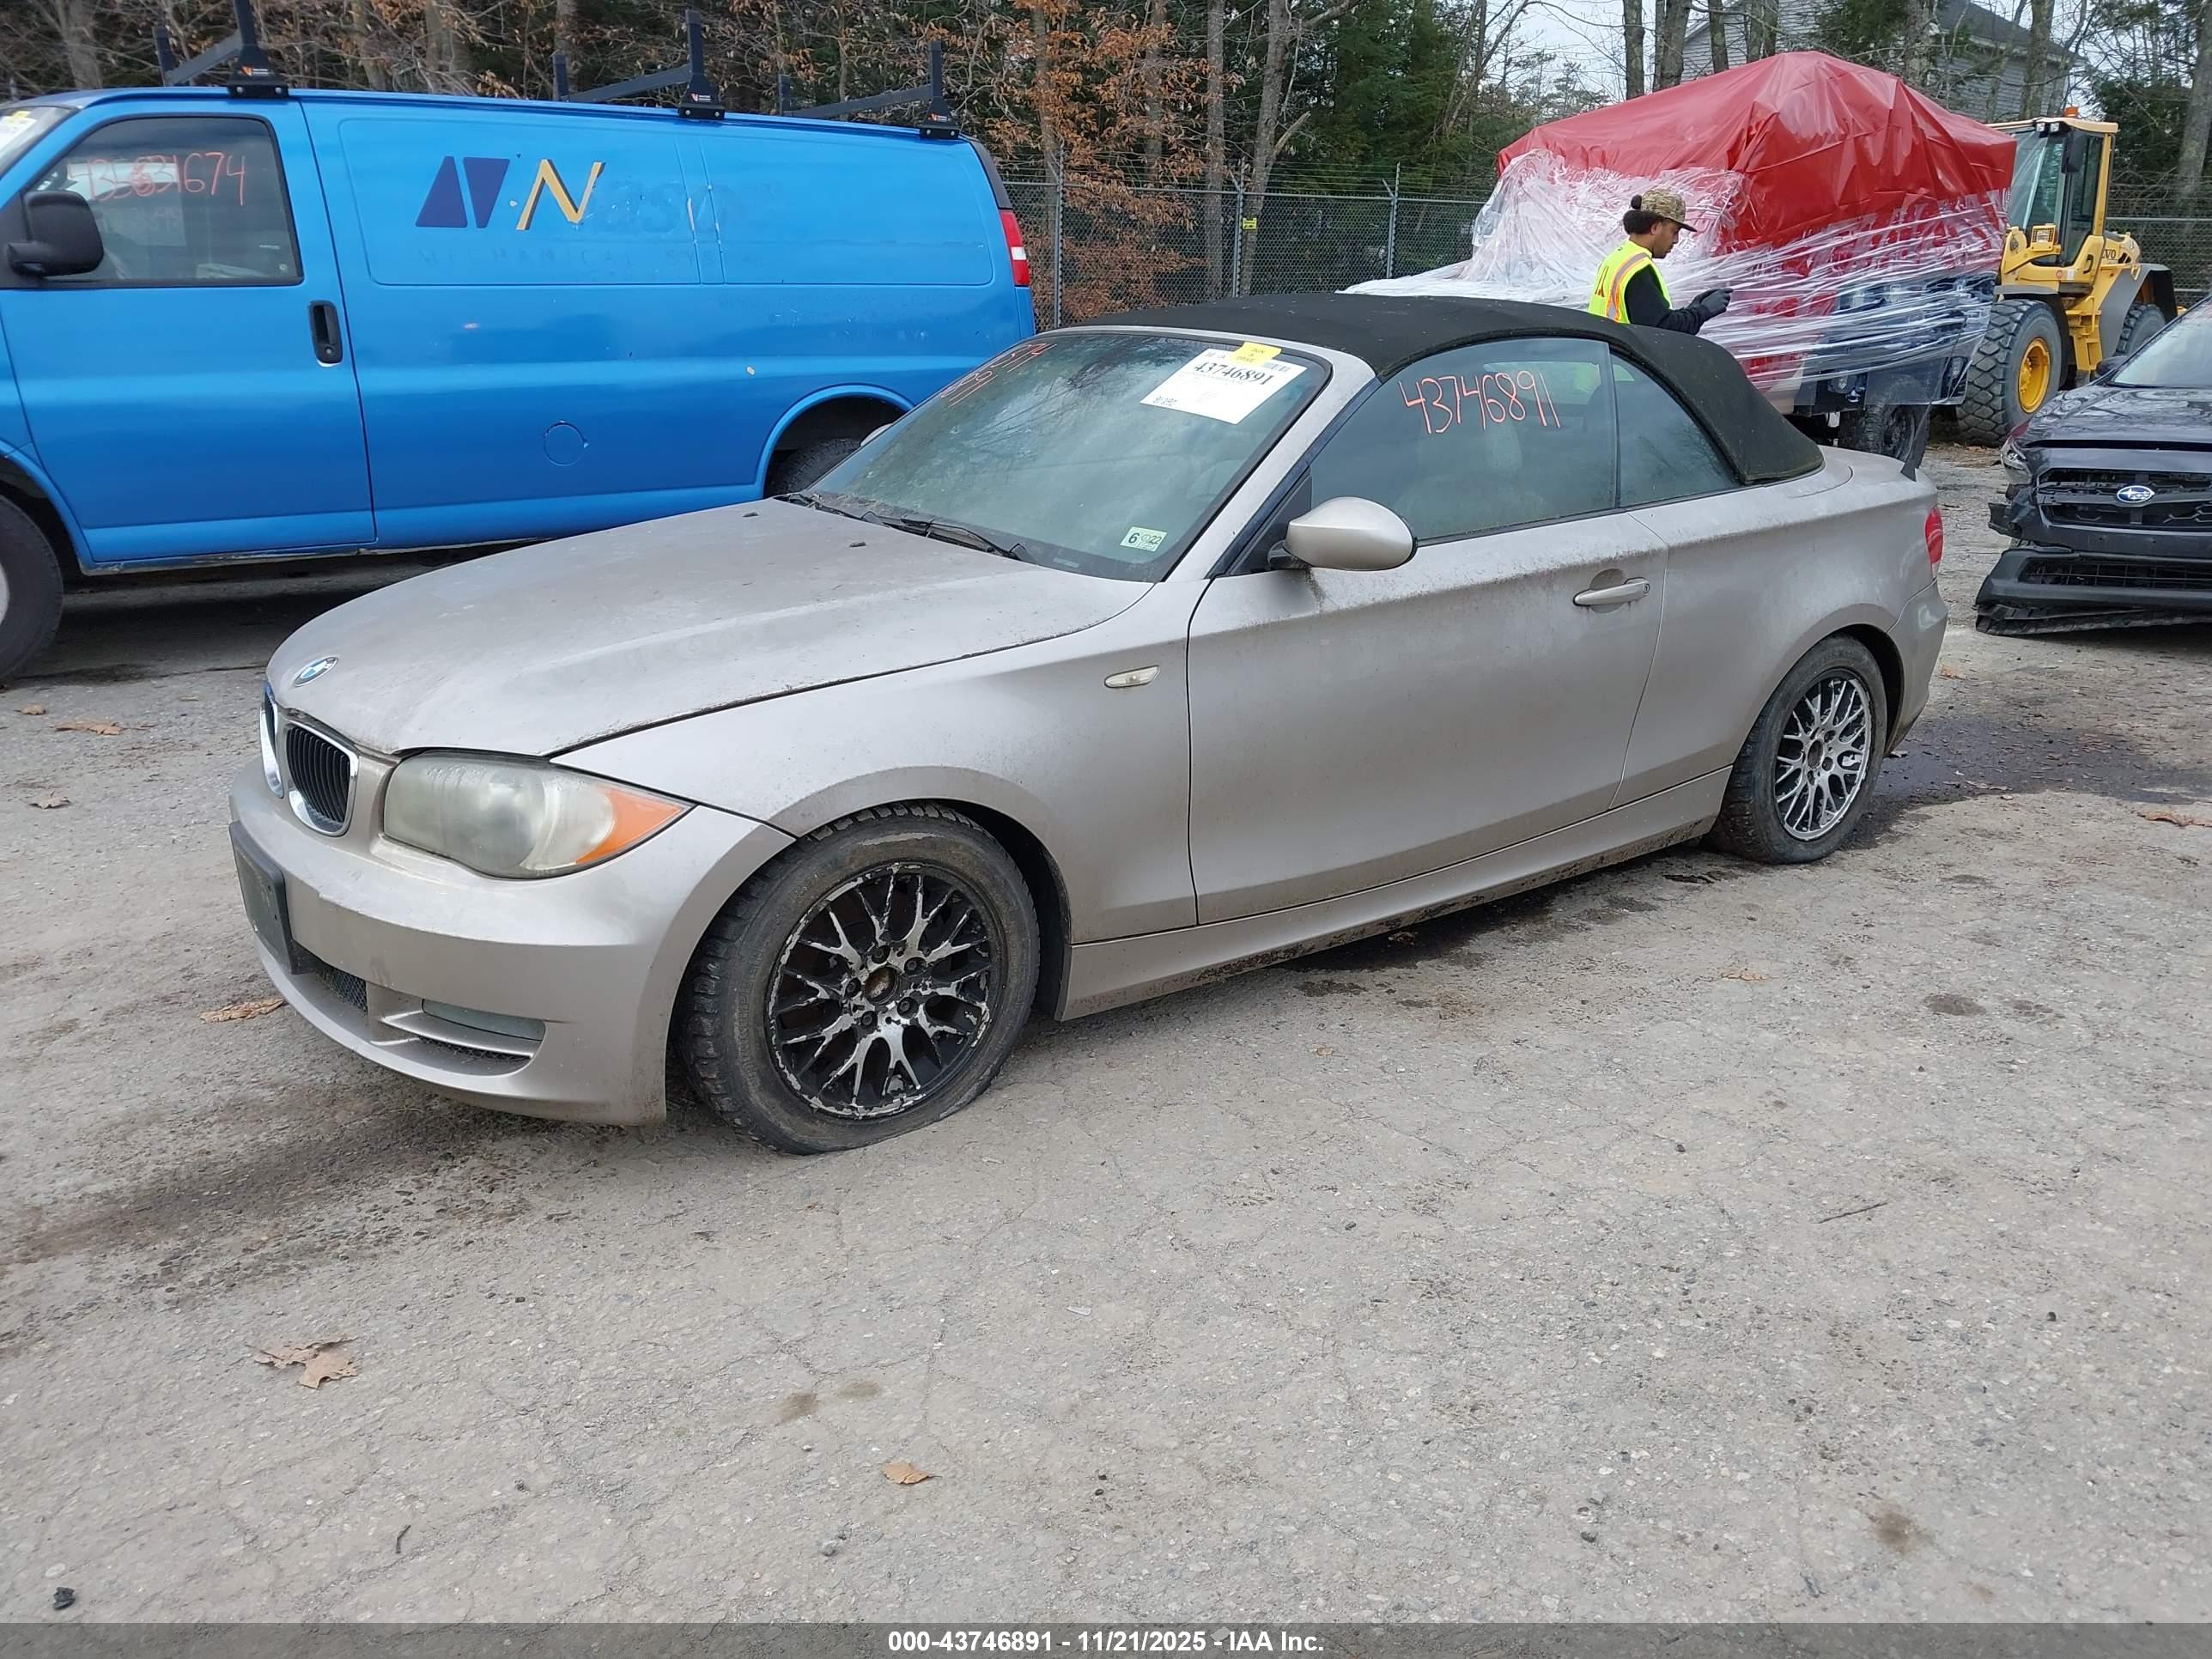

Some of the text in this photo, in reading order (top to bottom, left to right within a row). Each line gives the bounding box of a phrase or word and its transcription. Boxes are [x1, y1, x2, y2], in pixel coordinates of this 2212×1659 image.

[1194, 362, 1276, 385] 43746891
[1398, 370, 1561, 434] 43746891
[1127, 532, 1140, 544] 6
